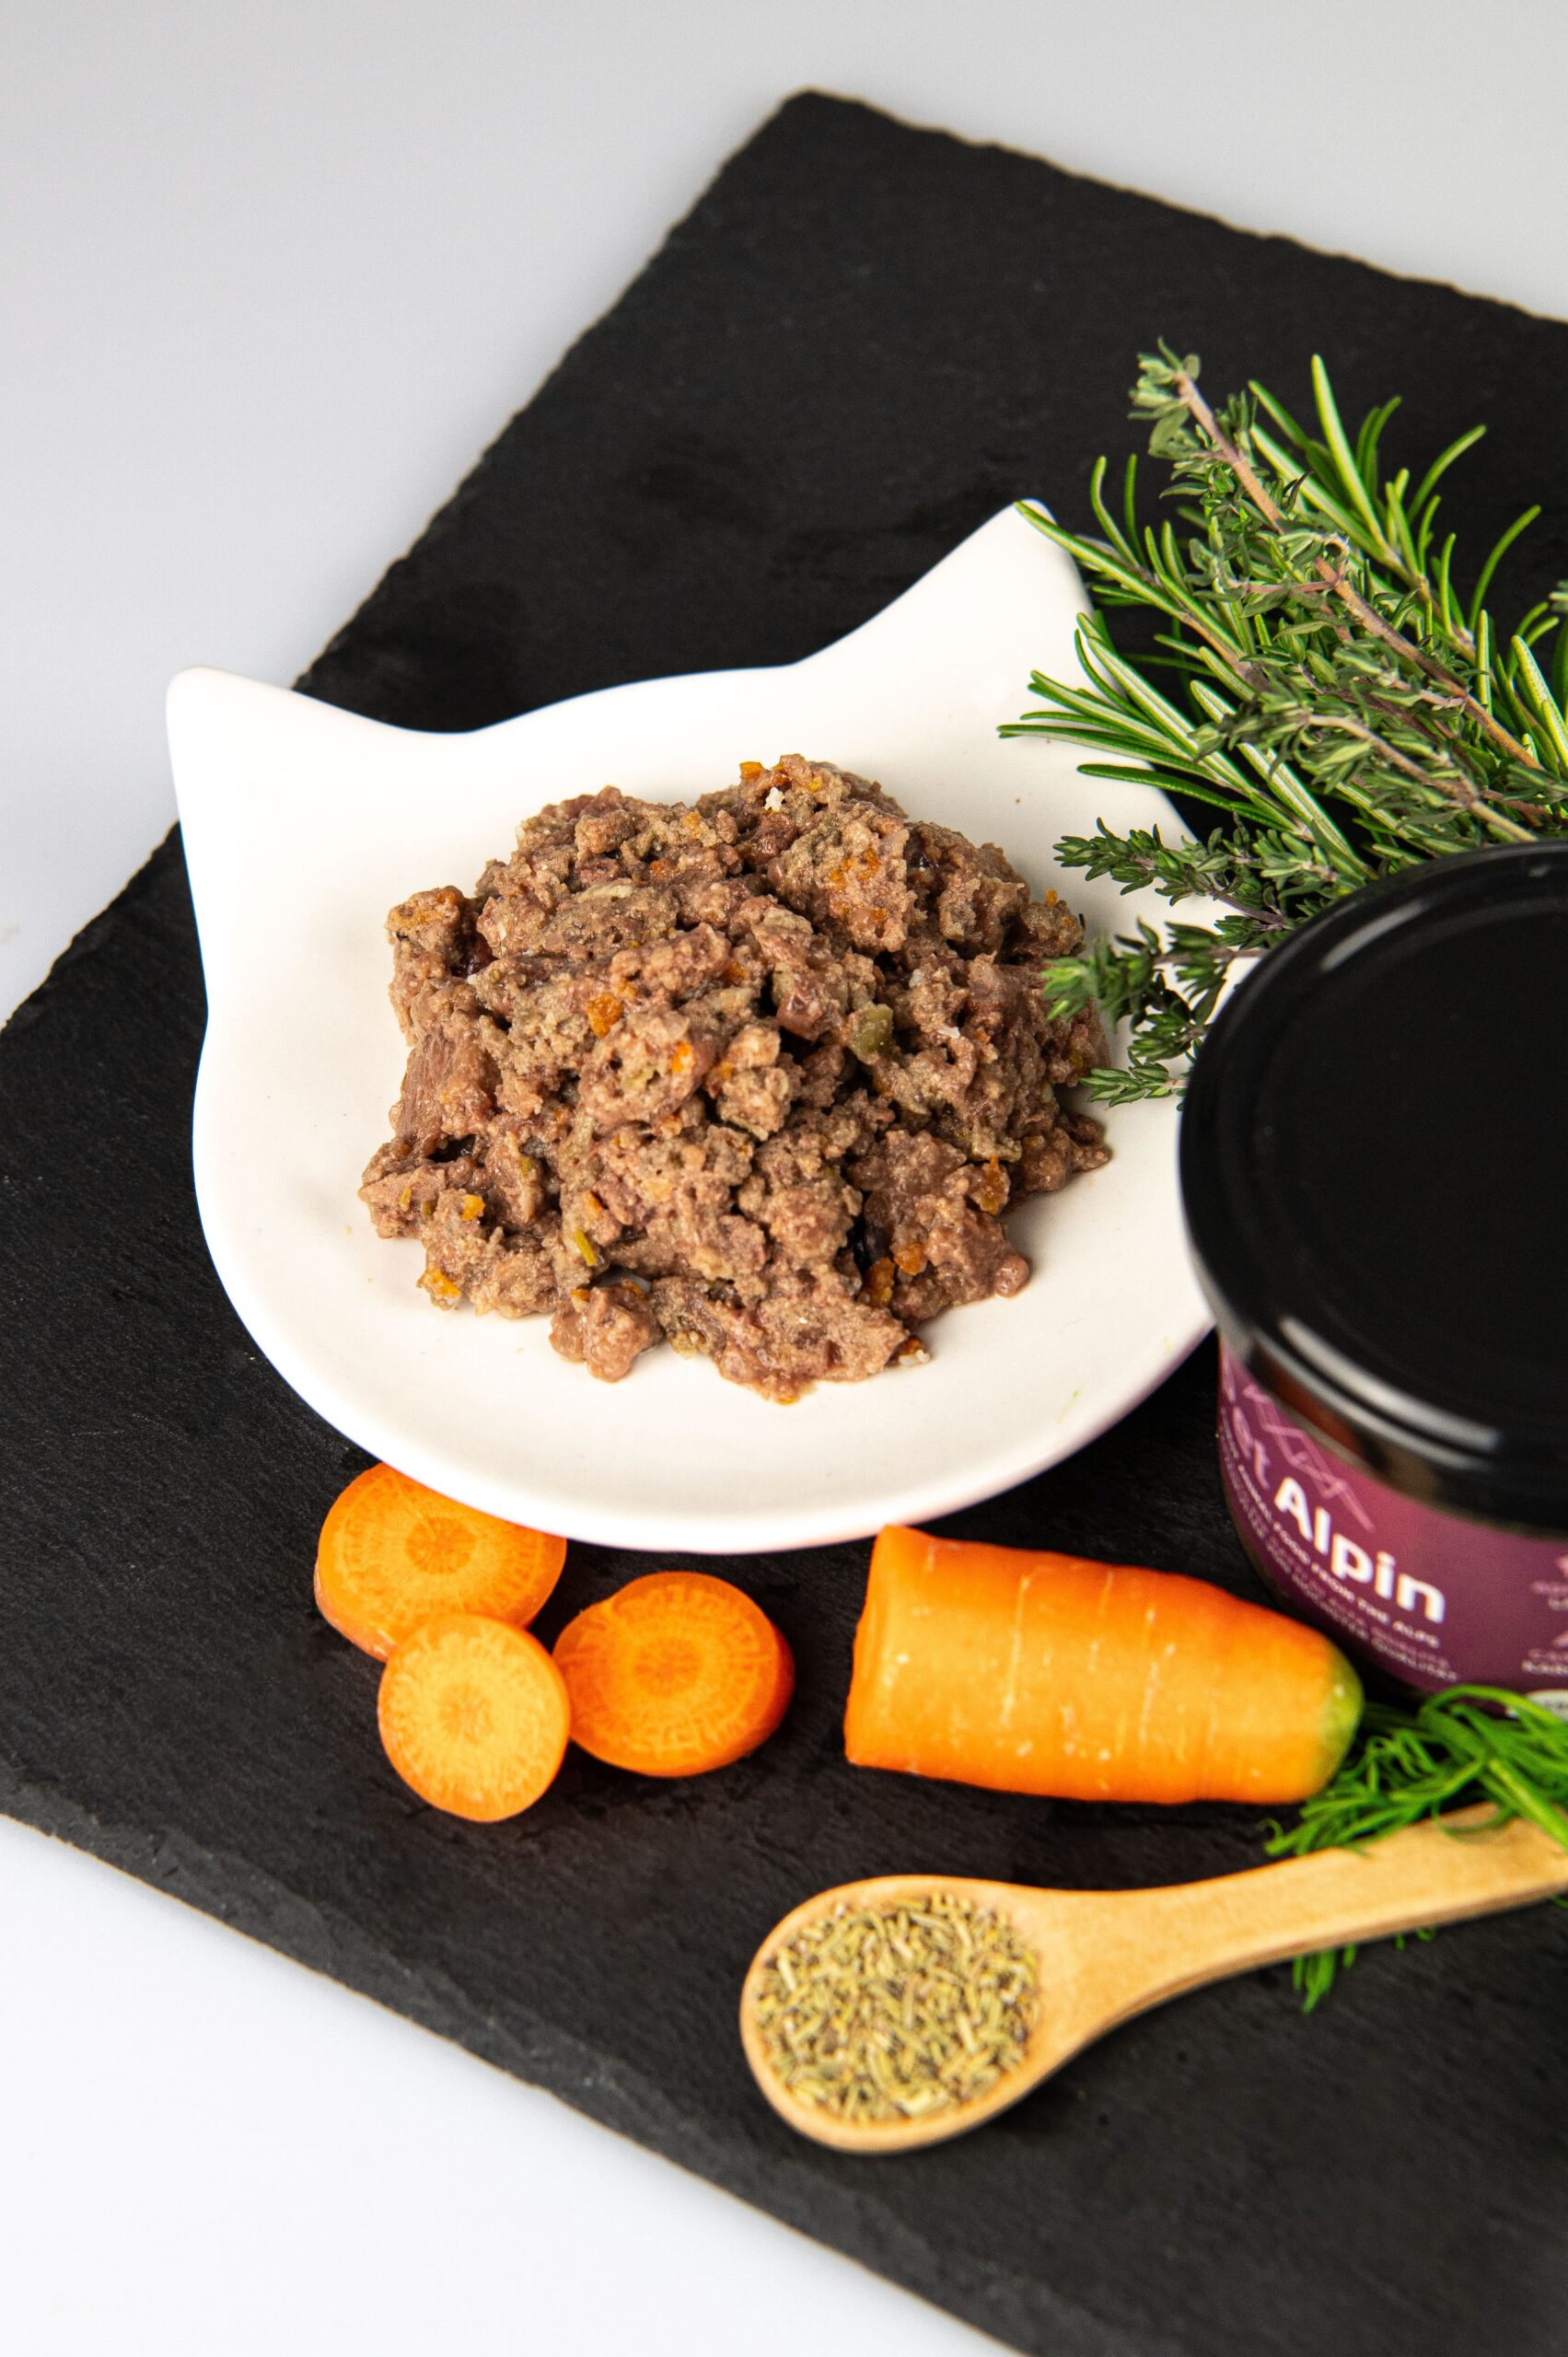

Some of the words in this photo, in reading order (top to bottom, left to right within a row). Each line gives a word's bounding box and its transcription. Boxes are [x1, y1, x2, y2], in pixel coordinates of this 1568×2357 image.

[1272, 1520, 1311, 1565] FOOD
[1311, 1562, 1356, 1603] FROM
[1356, 1596, 1391, 1626] THE
[1392, 1620, 1441, 1650] ALPS
[1274, 1477, 1446, 1625] Alpin
